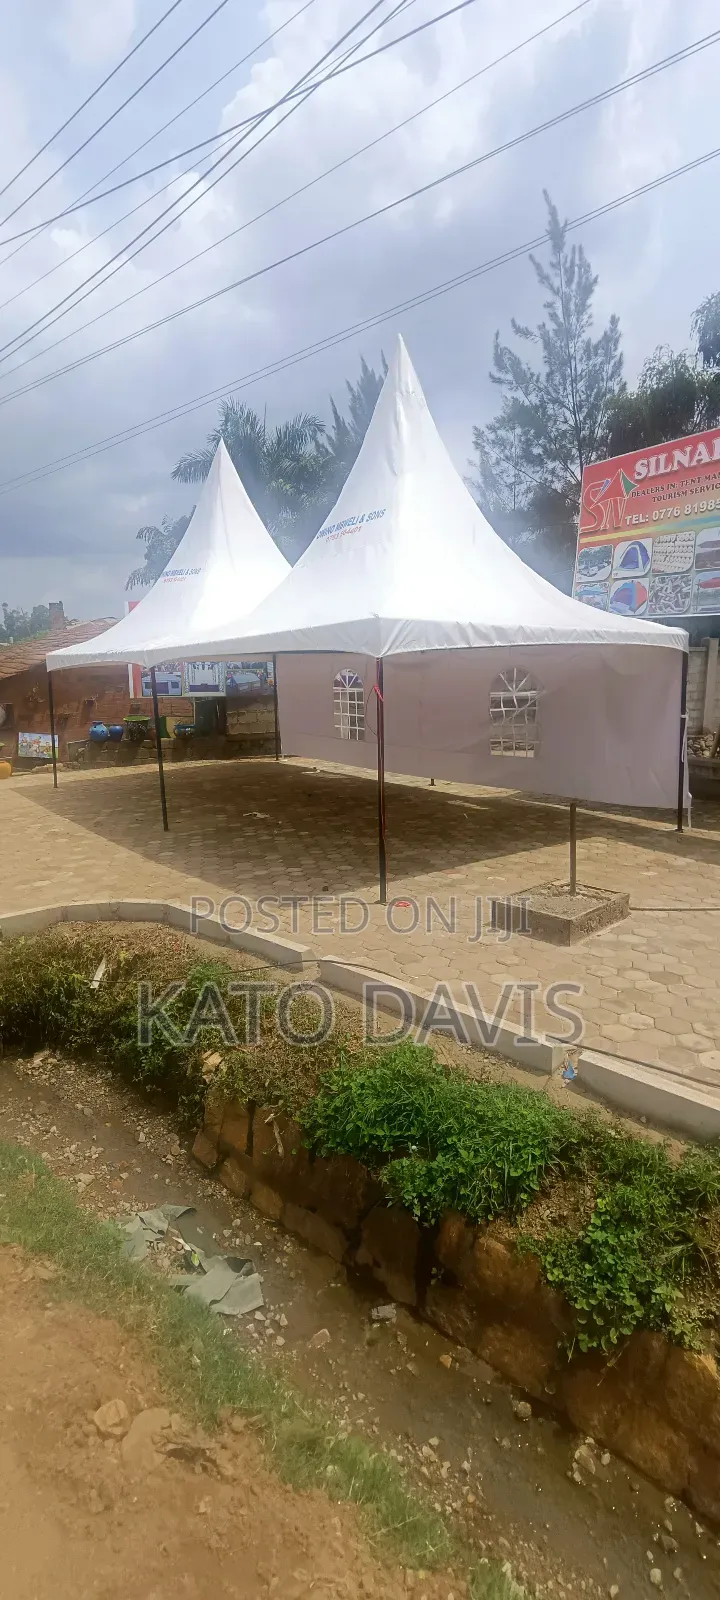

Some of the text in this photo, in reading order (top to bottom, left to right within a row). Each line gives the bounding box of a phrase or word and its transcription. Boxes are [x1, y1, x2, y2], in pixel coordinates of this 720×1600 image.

[631, 484, 665, 498] DEALERS
[680, 476, 702, 487] TENT
[652, 489, 688, 503] TOURISM
[359, 513, 366, 523] &
[366, 508, 387, 523] SONS
[625, 513, 649, 525] TEL:
[652, 506, 681, 521] 0776
